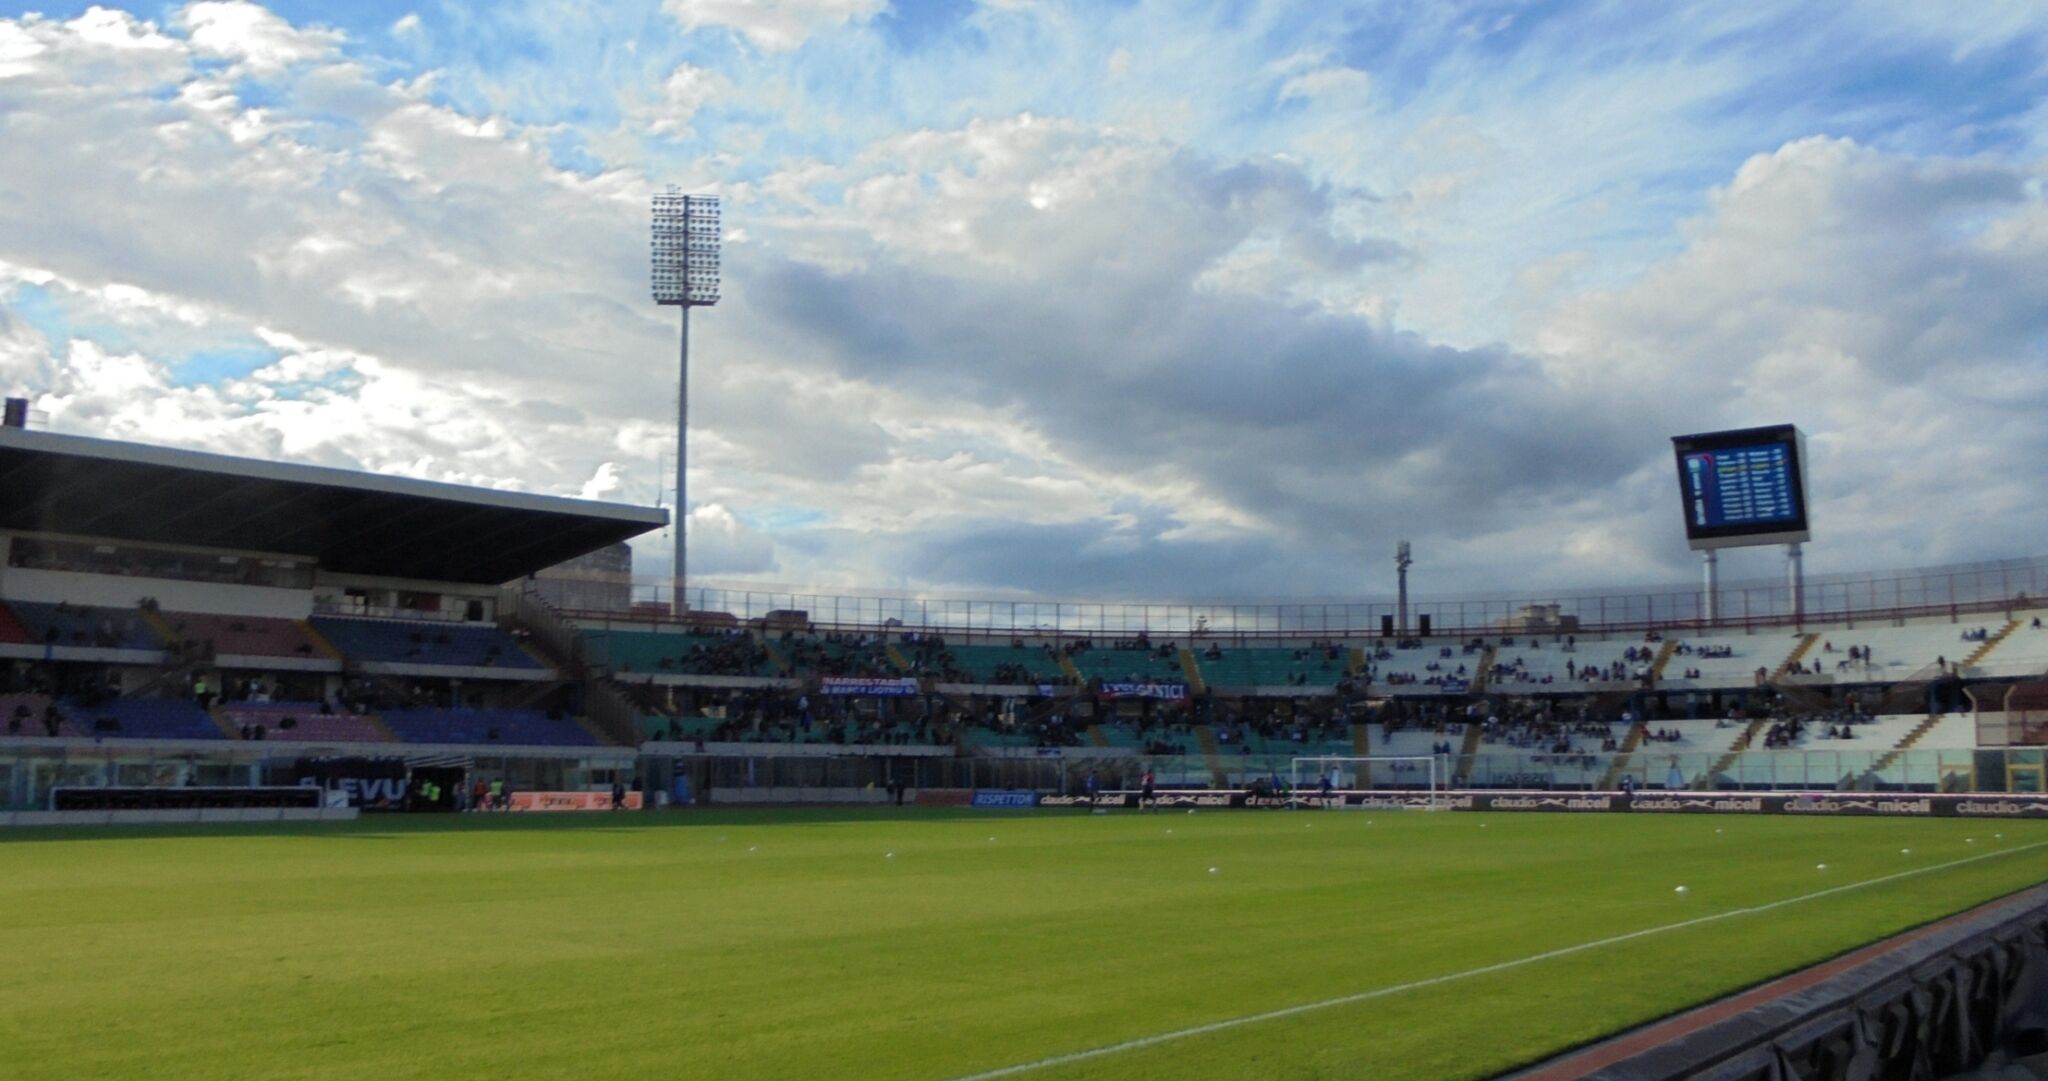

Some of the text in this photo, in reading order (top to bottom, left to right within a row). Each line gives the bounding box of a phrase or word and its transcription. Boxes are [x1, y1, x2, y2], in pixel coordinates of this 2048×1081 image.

[1490, 796, 1610, 808] claudio miceli
[1714, 798, 1762, 810] miceli
[1877, 798, 1931, 812] miceli
[1956, 799, 2020, 813] claudio
